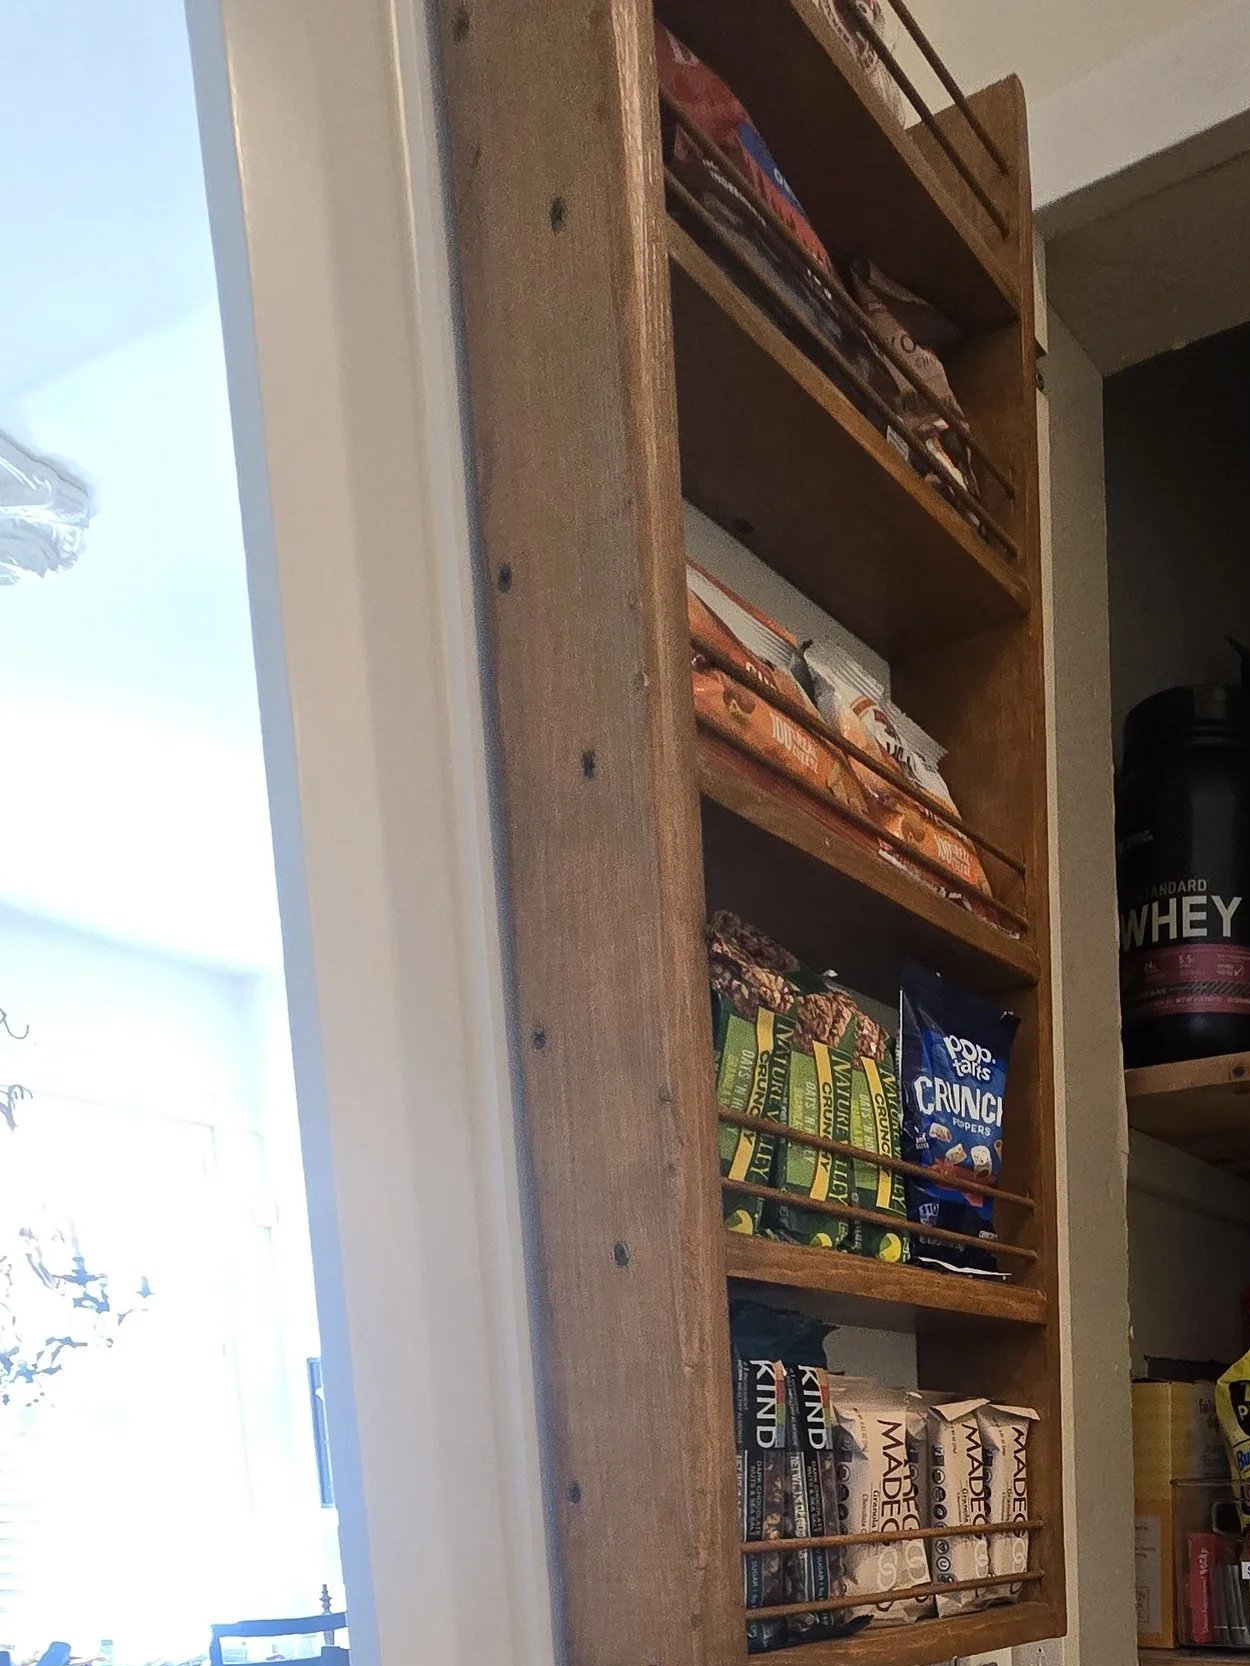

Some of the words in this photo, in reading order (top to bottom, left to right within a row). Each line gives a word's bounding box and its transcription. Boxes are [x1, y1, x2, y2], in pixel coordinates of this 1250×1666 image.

[1145, 879, 1208, 899] TANDARD
[1120, 895, 1243, 952] WHEY
[738, 1049, 756, 1080] OATS
[772, 1021, 795, 1106] NATURE
[953, 1059, 991, 1082] tarts
[741, 1050, 771, 1147] CRUNCY
[804, 1081, 817, 1110] OATS
[831, 1056, 853, 1136] NATURE
[878, 1068, 902, 1142] NATURE
[749, 1108, 779, 1181] VLLEY
[874, 1093, 892, 1177] CRUNC
[952, 1116, 991, 1137] POPPERS
[749, 1360, 778, 1449] KIND
[797, 1365, 827, 1449] KIND
[790, 1456, 801, 1471] NET
[814, 1484, 823, 1532] CHOCOLATE
[860, 1493, 870, 1526] Chocolate
[870, 1489, 881, 1529] Granola
[750, 1560, 759, 1587] SUGAR
[816, 1555, 825, 1580] SUGAR
